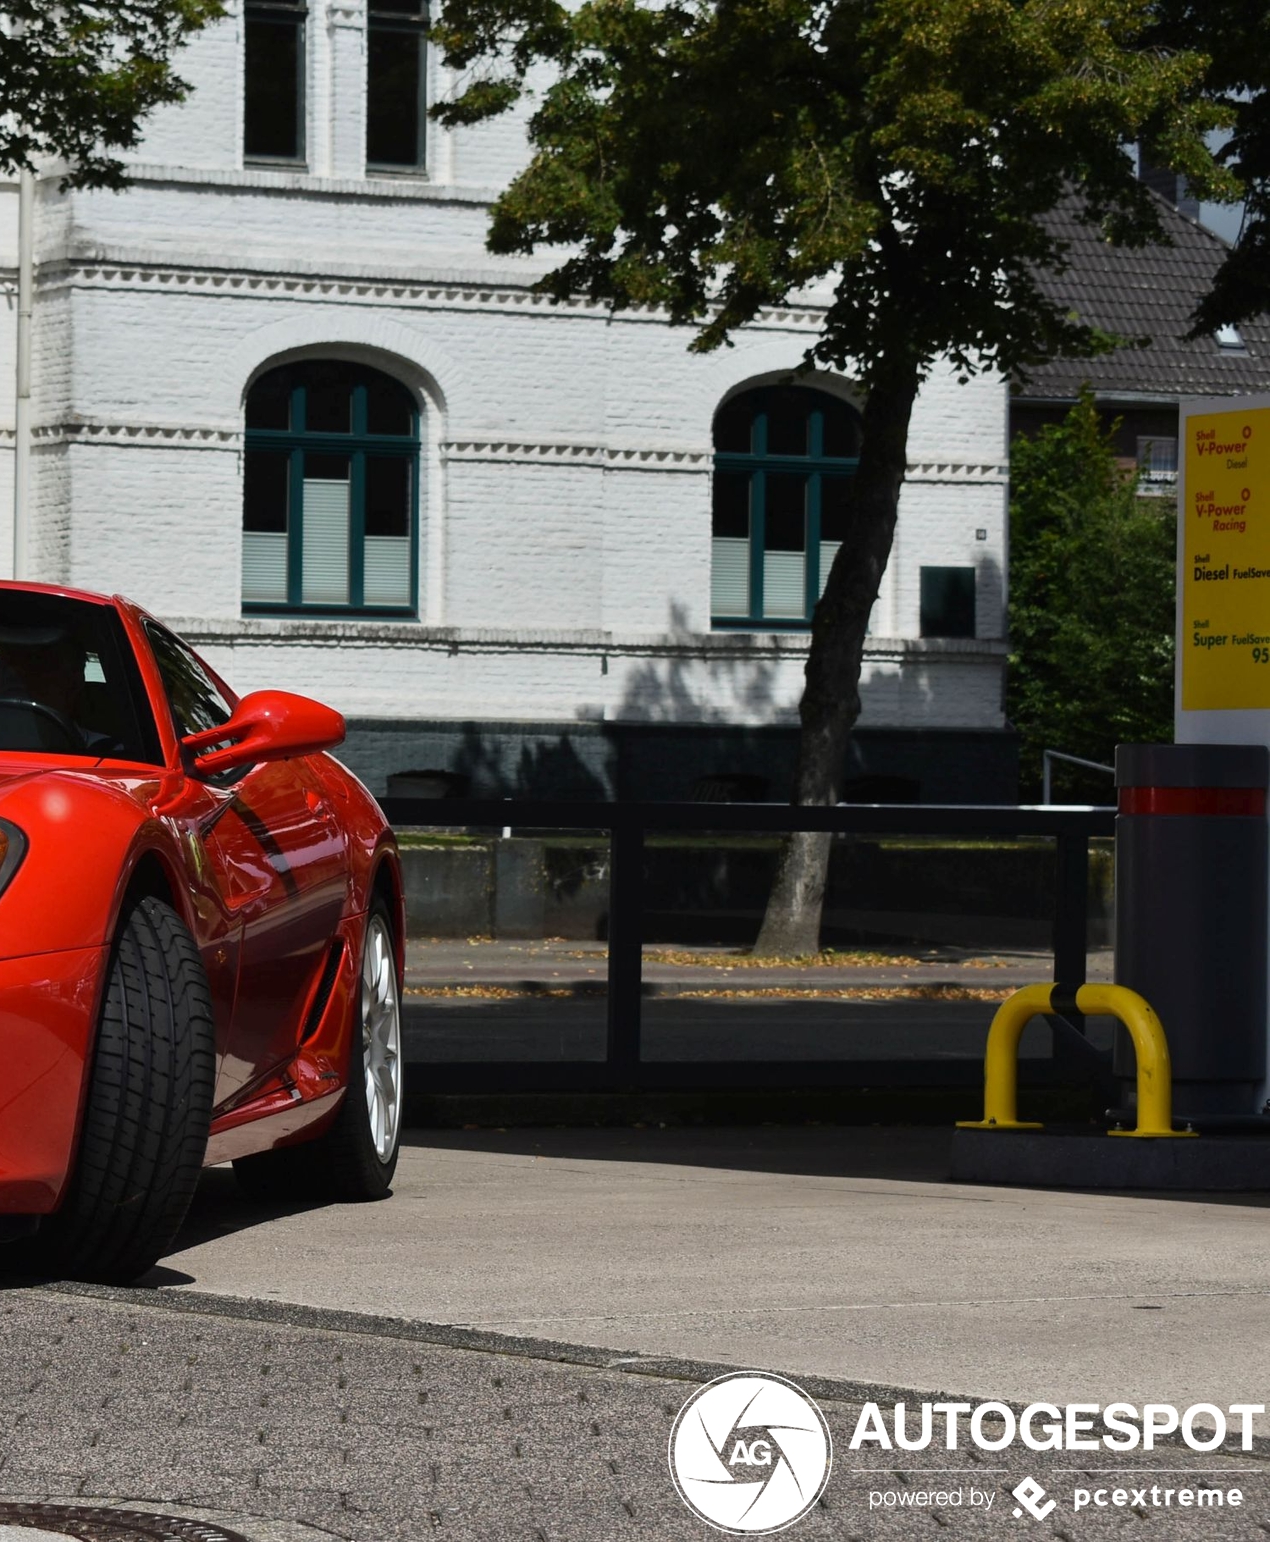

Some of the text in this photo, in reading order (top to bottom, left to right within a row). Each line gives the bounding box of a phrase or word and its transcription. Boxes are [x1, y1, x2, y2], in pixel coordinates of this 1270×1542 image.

[1196, 429, 1216, 441] Shell
[1196, 442, 1247, 456] V-Power
[1227, 457, 1248, 470] Diesel
[1195, 491, 1215, 502] Shell
[1195, 503, 1246, 518] V-Power
[1212, 518, 1246, 533] Racing
[1194, 554, 1210, 563] Shell
[1194, 564, 1229, 581] Diesel
[1193, 620, 1209, 629] Shell
[1193, 632, 1228, 650] Super
[1252, 647, 1270, 664] 95
